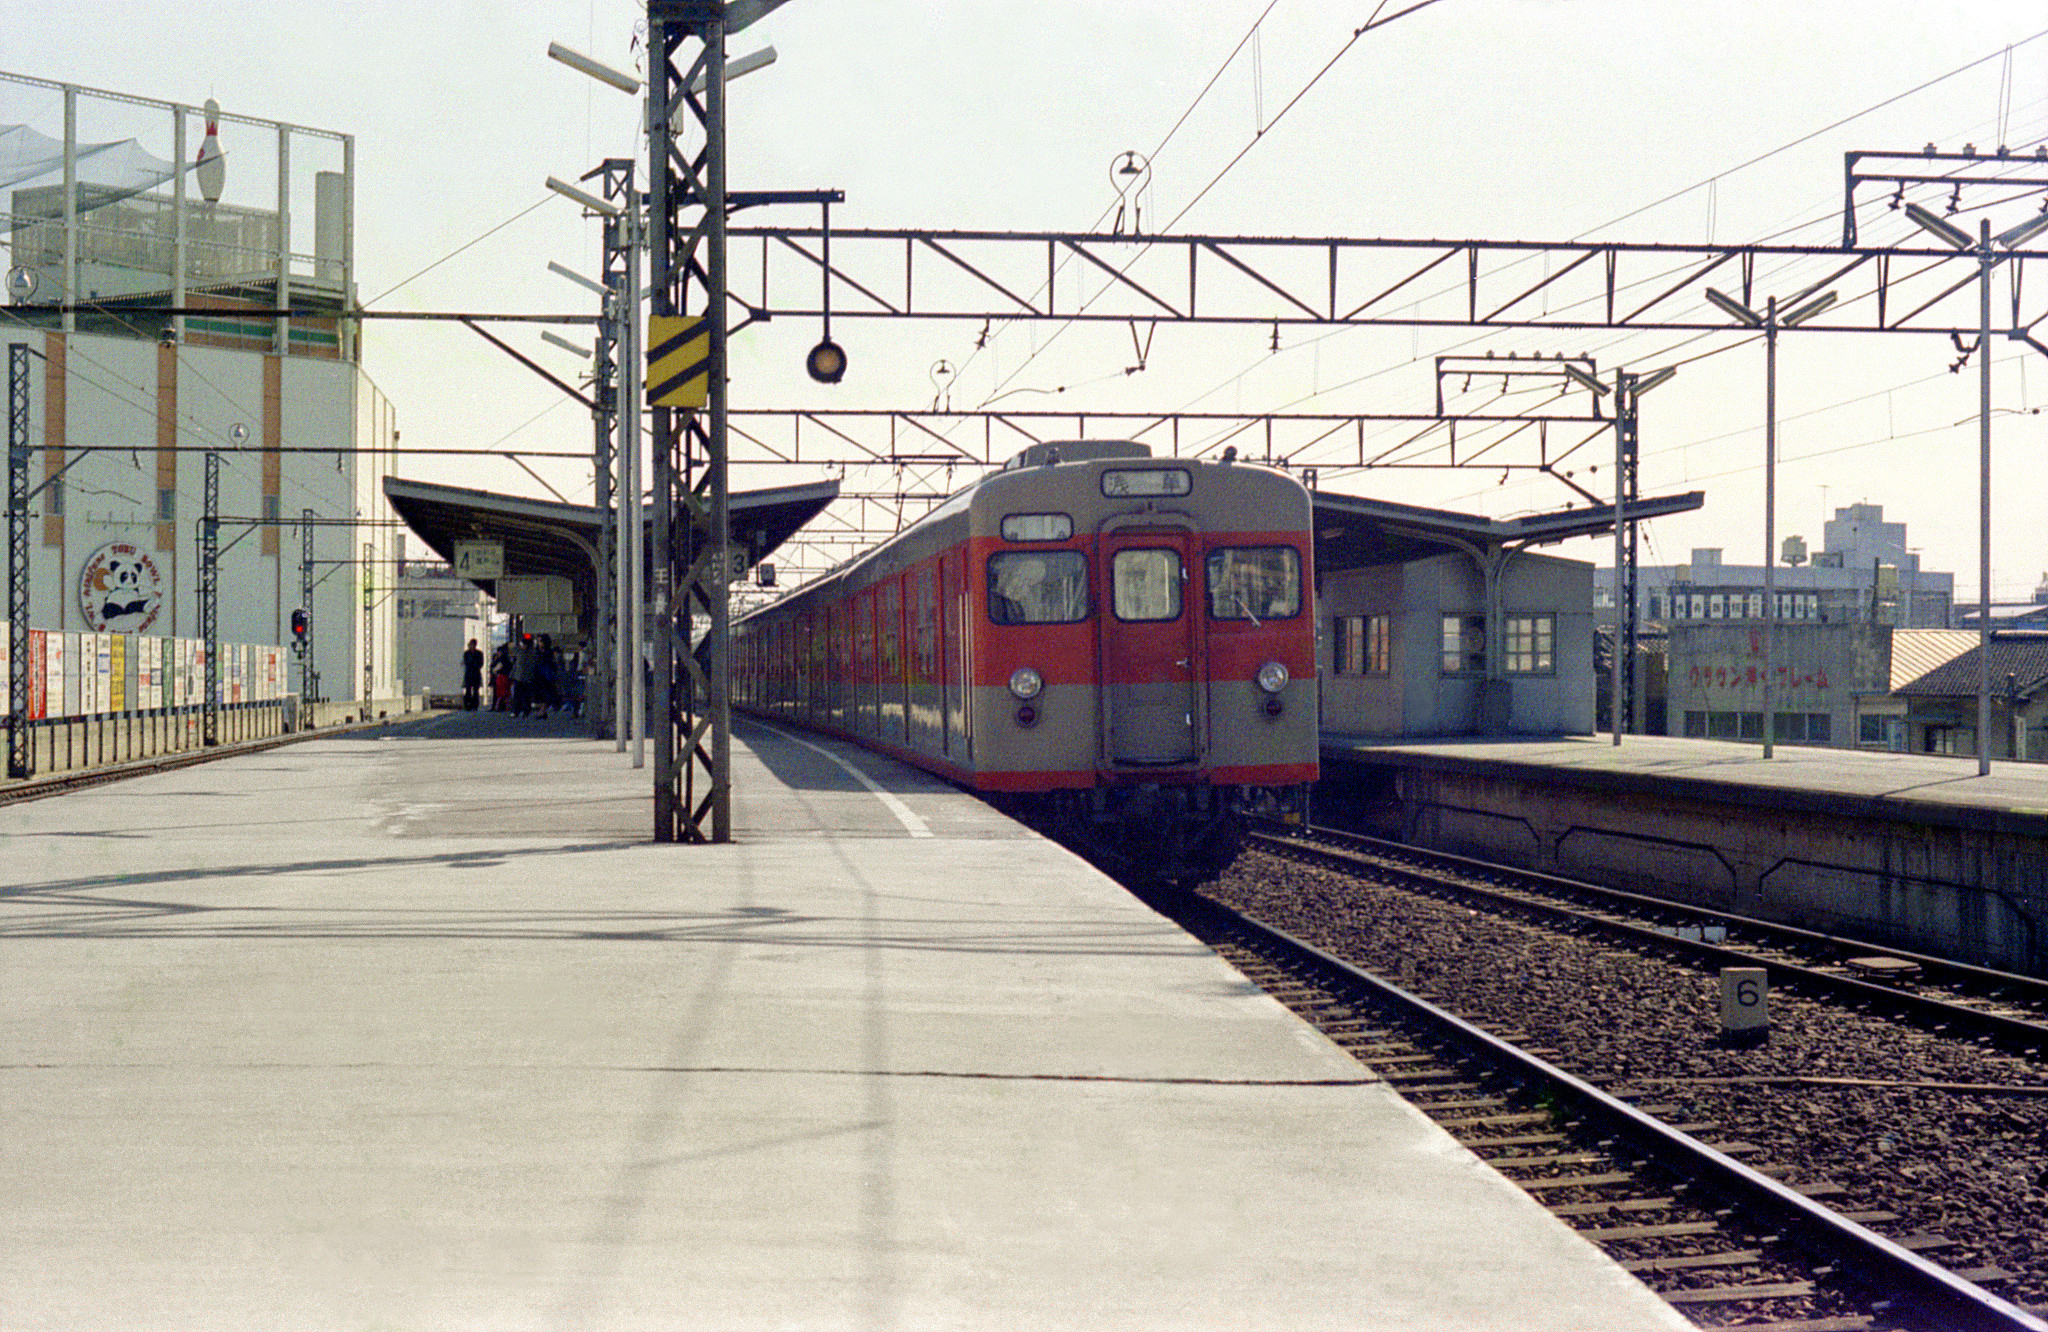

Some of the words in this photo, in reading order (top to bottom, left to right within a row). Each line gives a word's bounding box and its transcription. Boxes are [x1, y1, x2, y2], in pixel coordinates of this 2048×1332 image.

[111, 544, 137, 556] TOBU
[141, 554, 160, 586] BOWL
[459, 551, 470, 571] 4
[733, 554, 745, 574] 3
[1737, 979, 1759, 1007] 6
